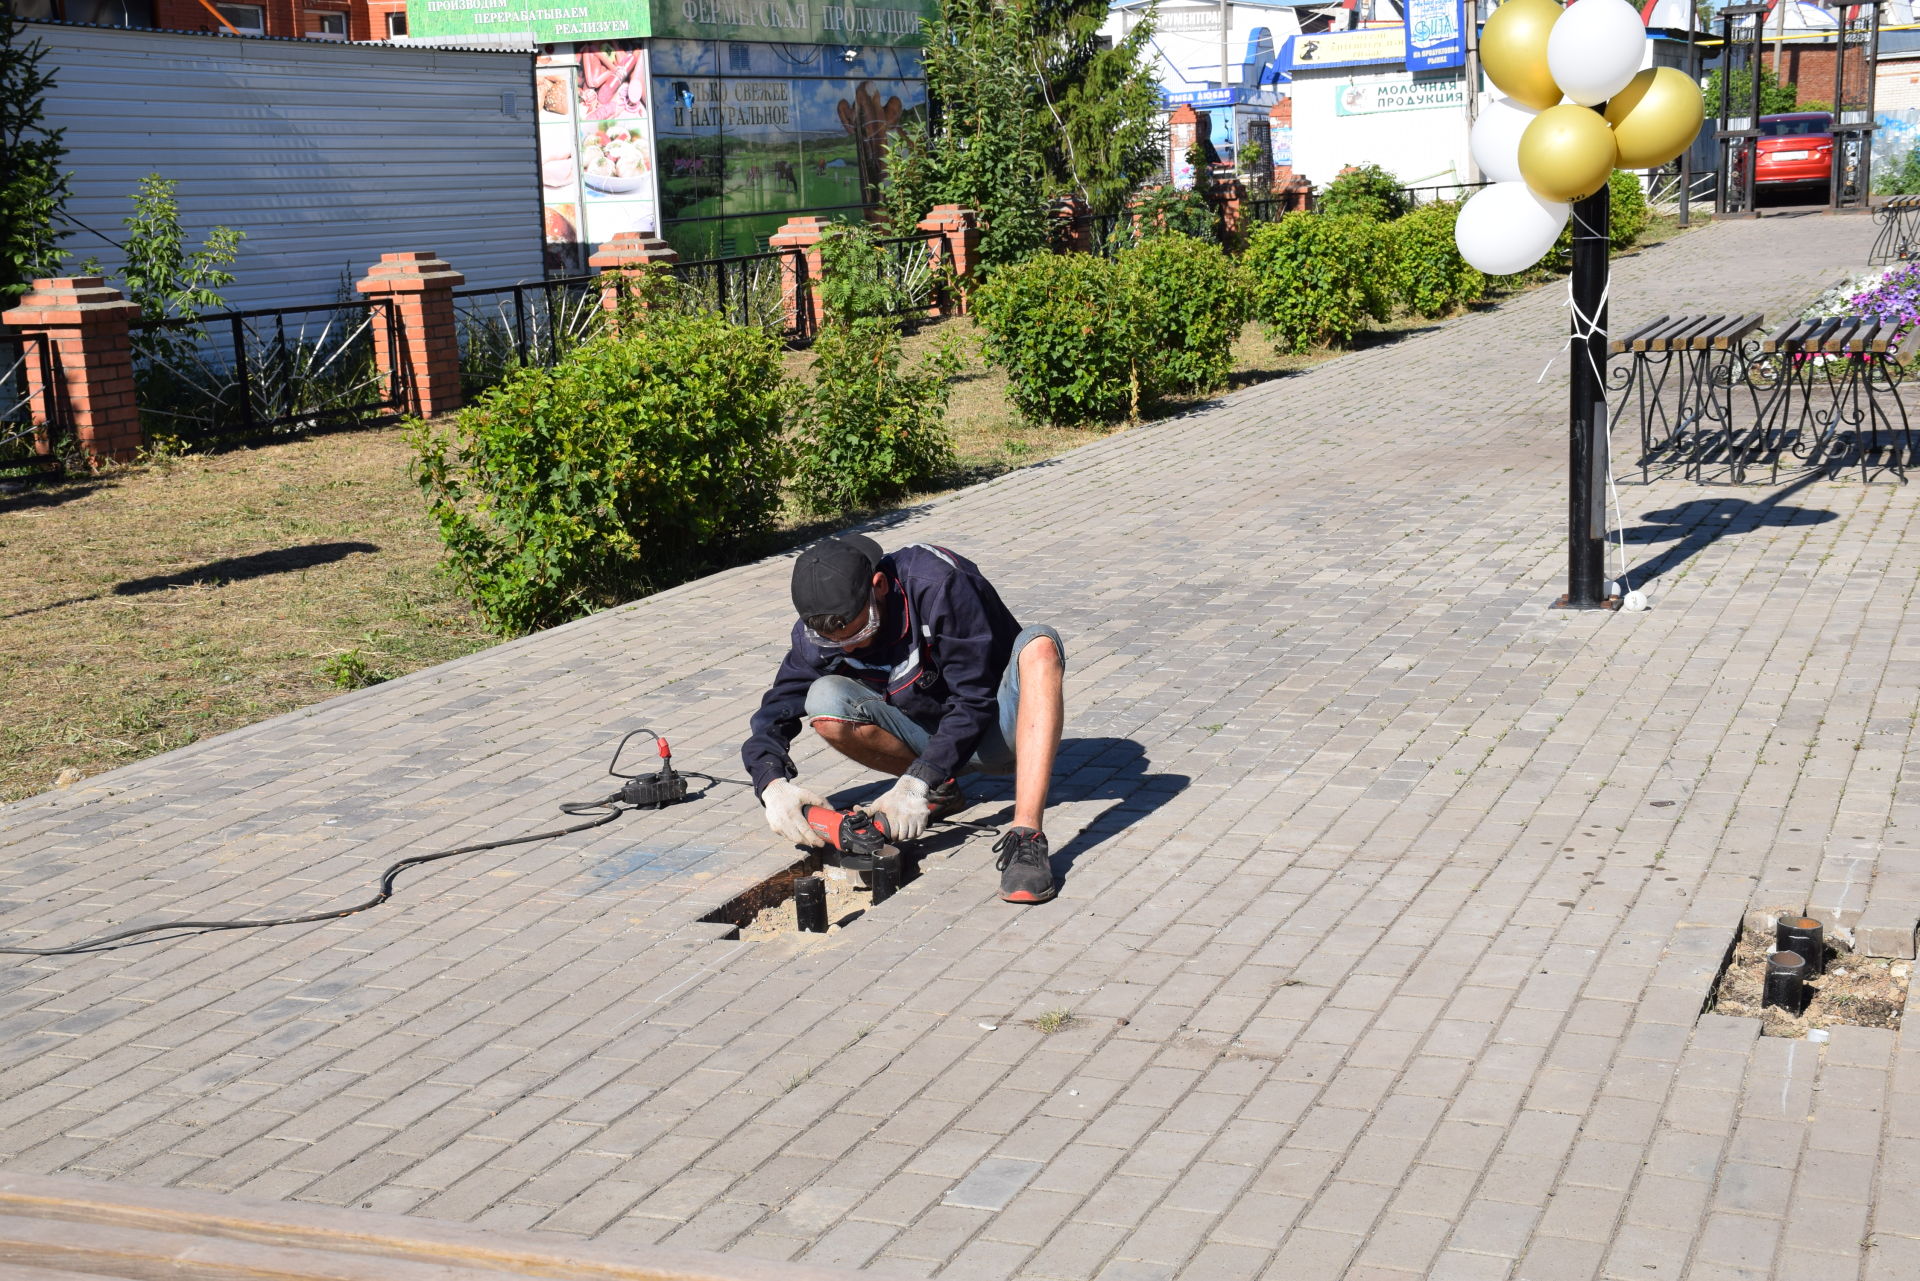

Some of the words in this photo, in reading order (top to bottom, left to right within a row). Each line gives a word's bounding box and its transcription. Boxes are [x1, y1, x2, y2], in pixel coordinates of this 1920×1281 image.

[427, 0, 507, 12] ПРОИЗВОДИМ
[473, 7, 589, 24] ПЕРЕРАБАТЫВАЕМ
[682, 0, 808, 29] ФЕРМЕРСКАЯ
[821, 5, 921, 38] ПРОДУКЦИЯ
[554, 20, 630, 35] РЕАЛИЗУЕМ
[672, 82, 727, 102] ТЛЬКО
[734, 82, 788, 102] СВЕЖЕЕ
[1168, 92, 1195, 103] РЫБА
[1197, 89, 1231, 100] ЛЮБАЯ
[1377, 80, 1457, 96] МОЛОЧНАЯ
[1377, 92, 1463, 108] ПРОДУКЦИЯ
[674, 107, 685, 127] И
[690, 106, 789, 127] НАТУРАЛЬНОЕ
